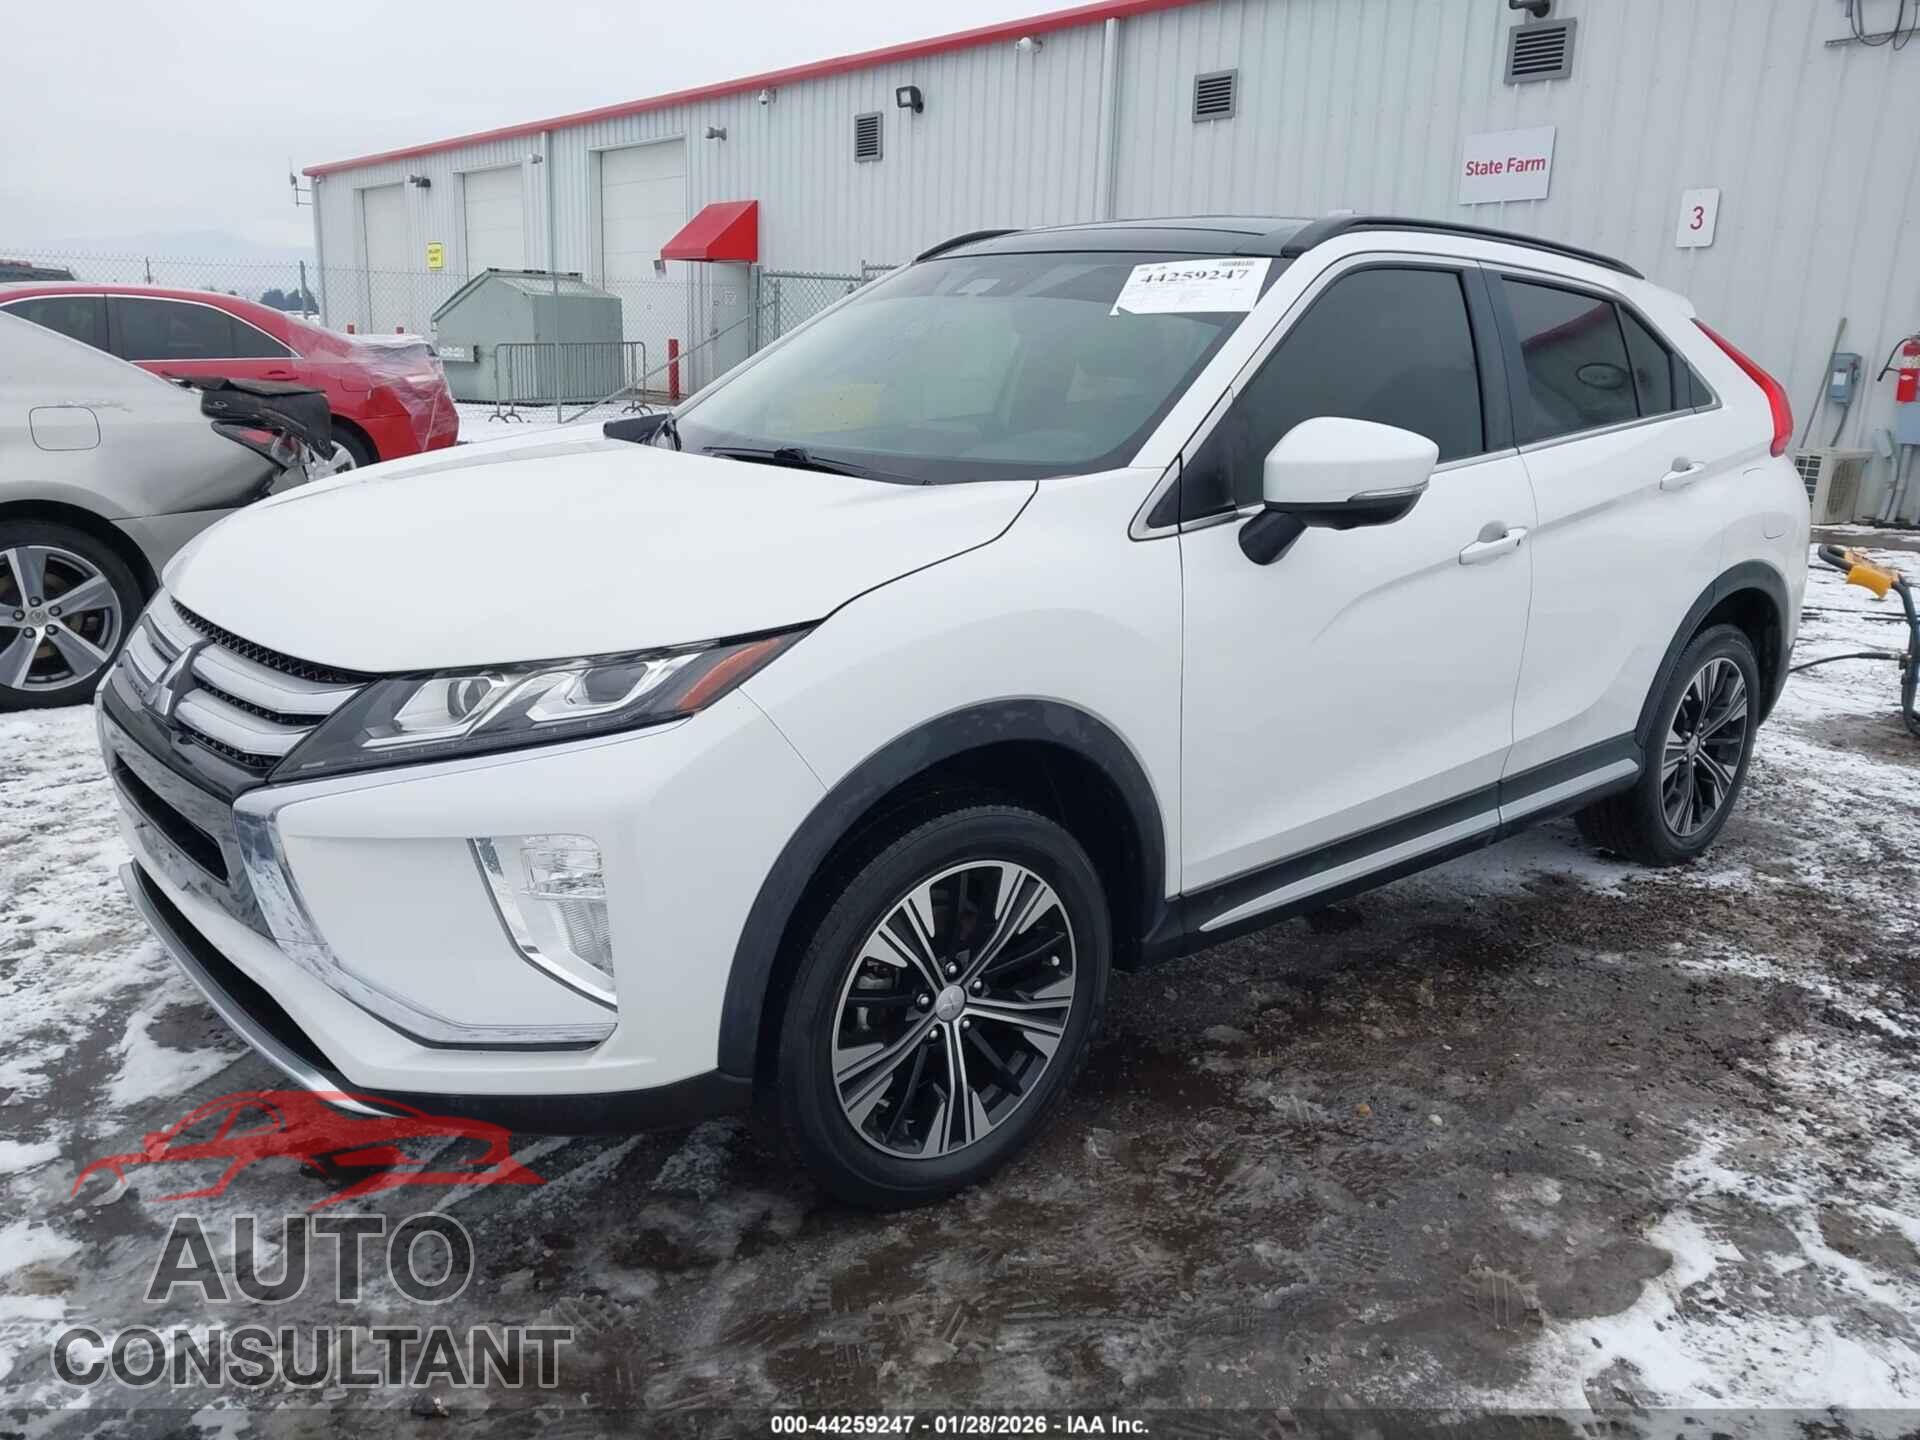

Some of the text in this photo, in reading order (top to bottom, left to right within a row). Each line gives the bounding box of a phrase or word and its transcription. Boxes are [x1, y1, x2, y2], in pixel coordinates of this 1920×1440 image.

[1466, 156, 1546, 176] State Farm
[1690, 205, 1705, 230] 3
[1141, 269, 1248, 283] 44259247
